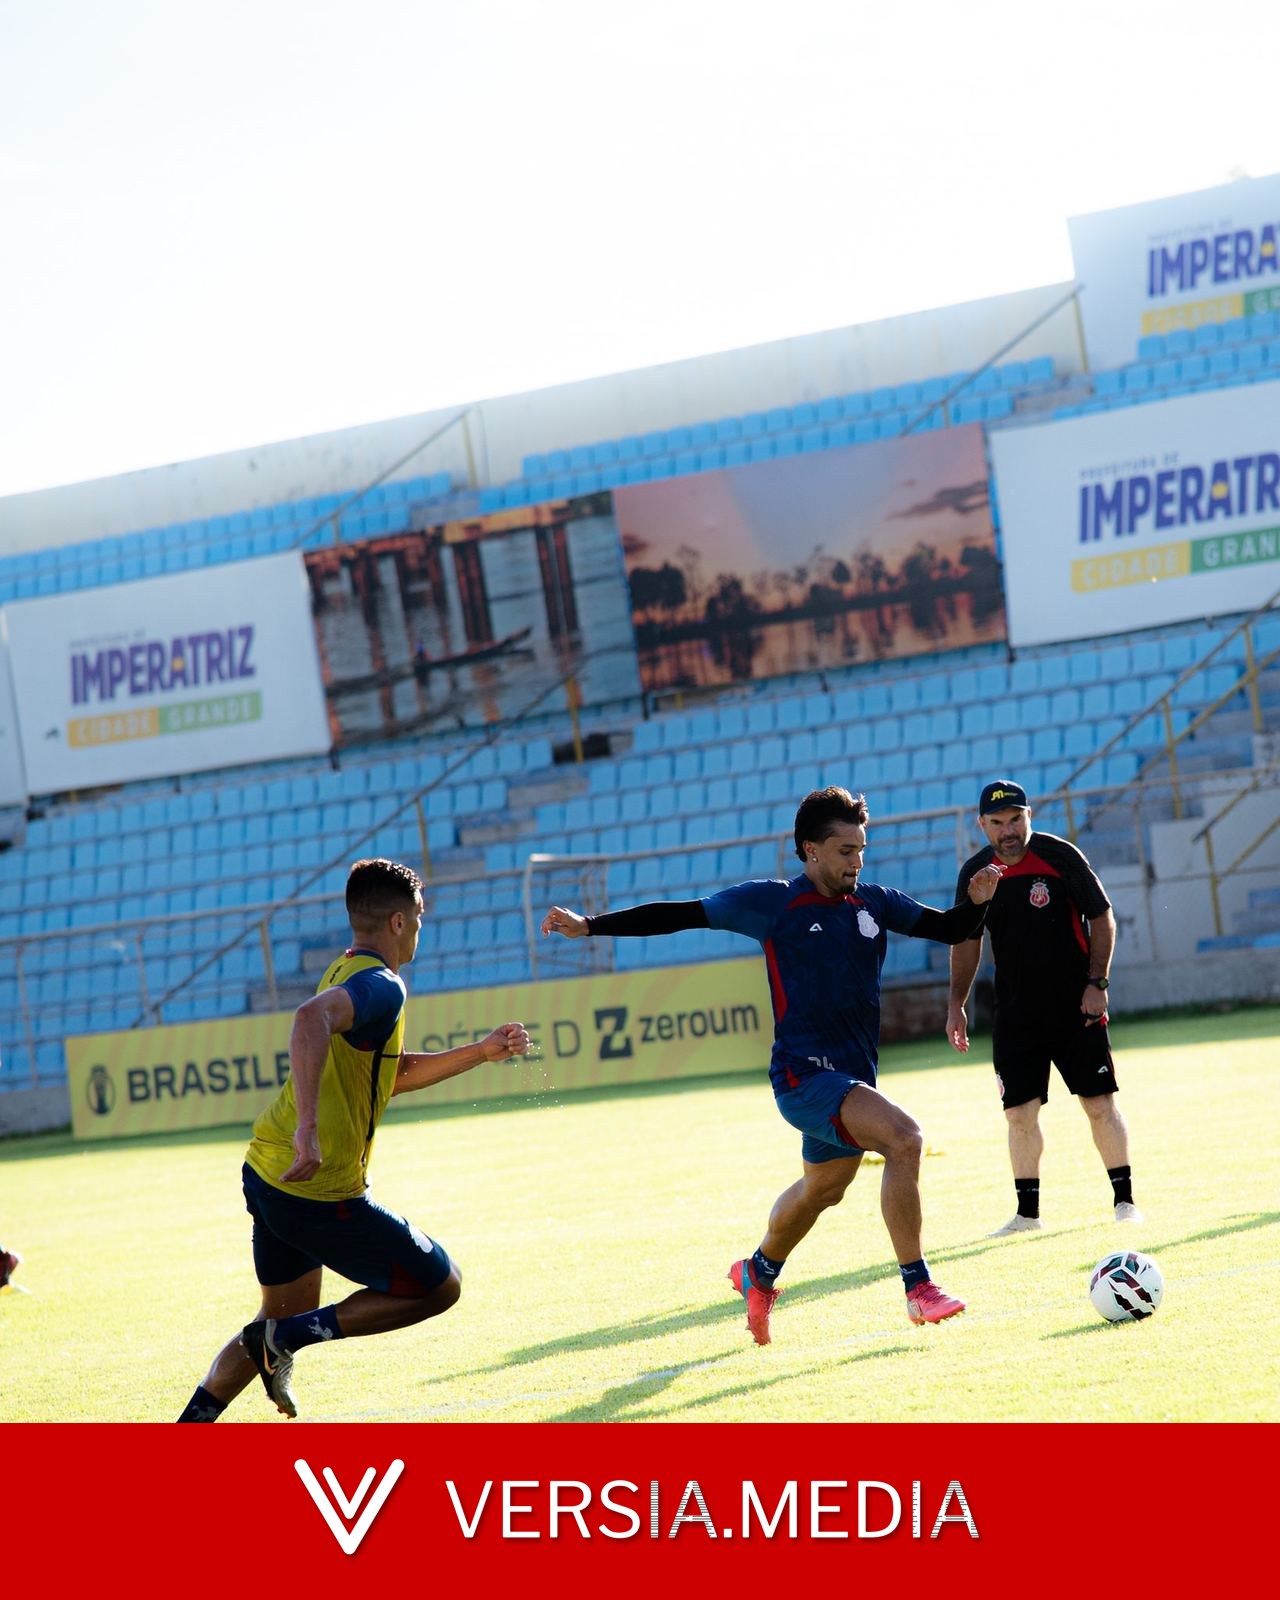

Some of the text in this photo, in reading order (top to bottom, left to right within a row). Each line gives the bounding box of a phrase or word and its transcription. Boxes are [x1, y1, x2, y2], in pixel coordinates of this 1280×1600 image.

[1147, 223, 1280, 299] IMPERA
[1082, 532, 1280, 588] CIDADE GRAN
[70, 623, 257, 707] IMPERATRIZ
[77, 696, 253, 743] CIDADE GRANDE
[553, 1020, 581, 1059] D
[639, 1003, 760, 1044] zeroum
